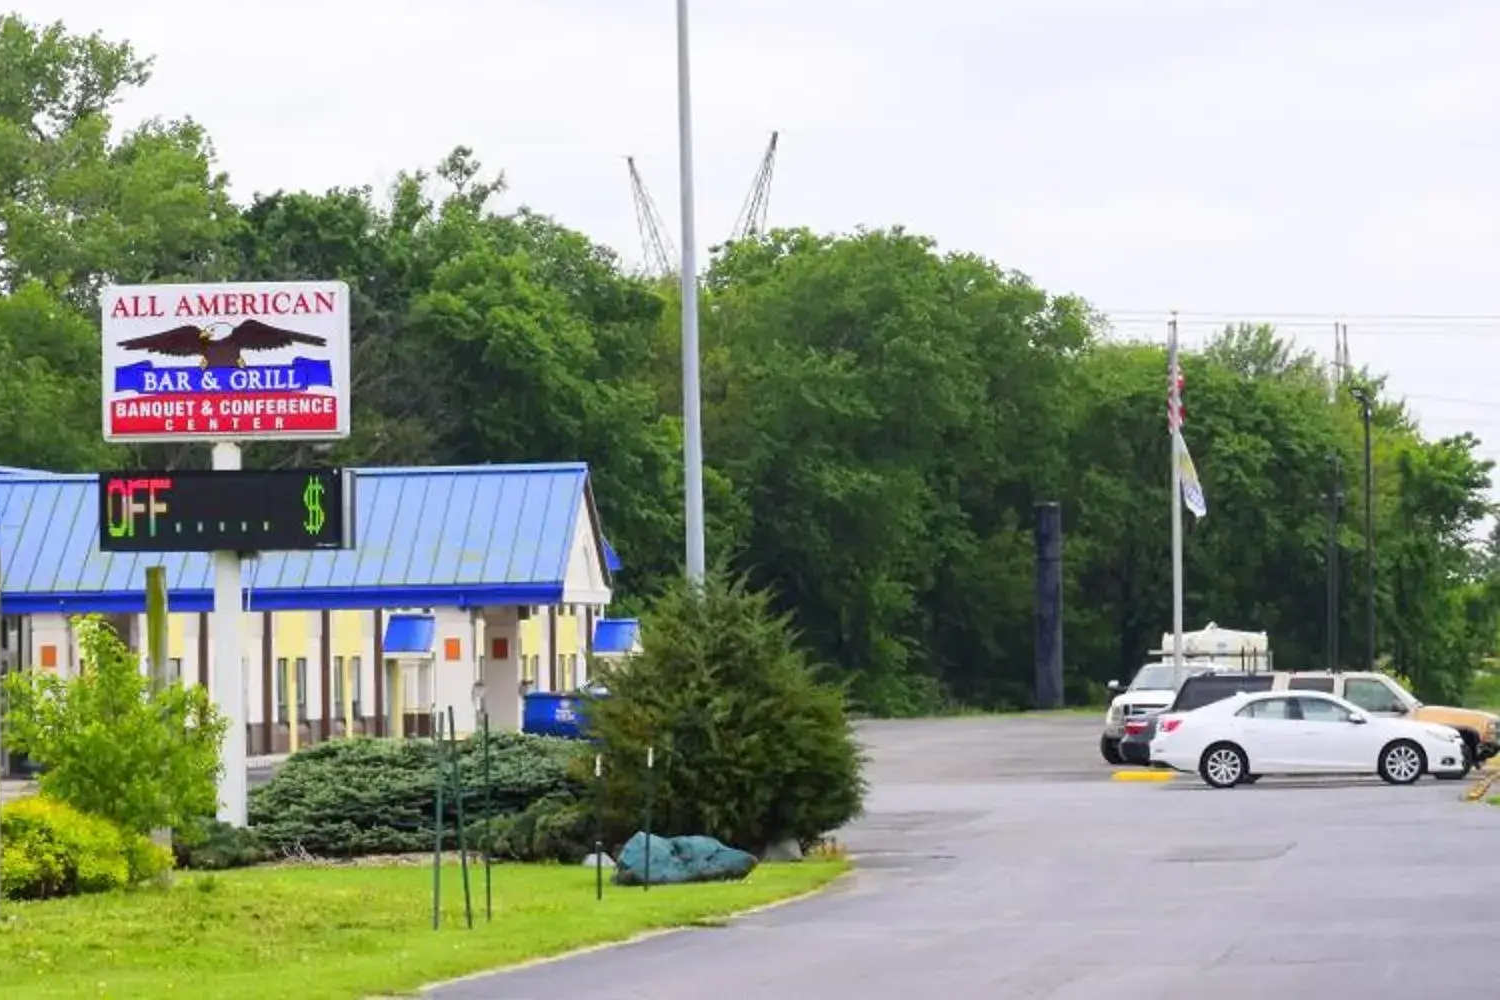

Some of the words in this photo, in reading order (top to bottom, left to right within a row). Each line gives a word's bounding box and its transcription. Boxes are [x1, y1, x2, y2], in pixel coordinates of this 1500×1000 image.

[111, 297, 164, 318] ALL
[175, 292, 335, 317] AMERICAN
[143, 372, 192, 392] BAR
[201, 372, 220, 390] &
[229, 369, 301, 389] GRILL
[115, 401, 194, 417] BANQUET
[200, 400, 214, 415] &
[219, 398, 334, 415] CONFERENCE
[165, 416, 284, 431] CENTER
[303, 475, 325, 535] $
